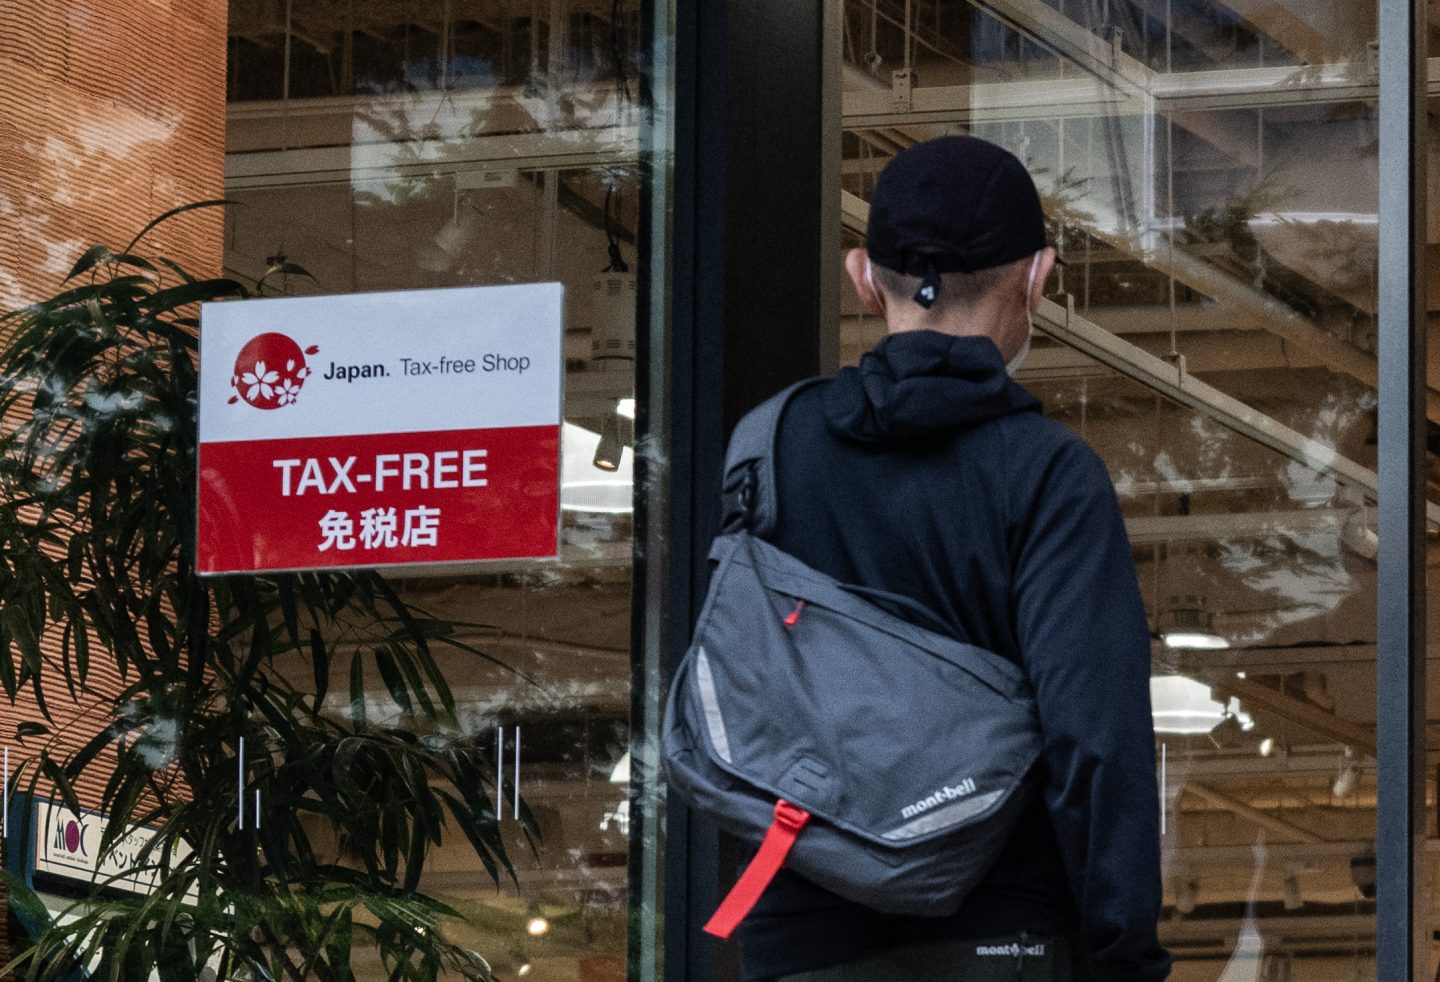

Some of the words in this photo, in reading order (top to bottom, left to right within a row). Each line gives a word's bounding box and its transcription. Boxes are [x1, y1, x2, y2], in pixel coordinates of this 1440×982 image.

[323, 361, 390, 383] Japan.
[400, 356, 476, 376] Tax-free
[482, 353, 531, 373] Shop
[272, 449, 489, 497] TAX-FREE
[317, 505, 441, 552] 免税店
